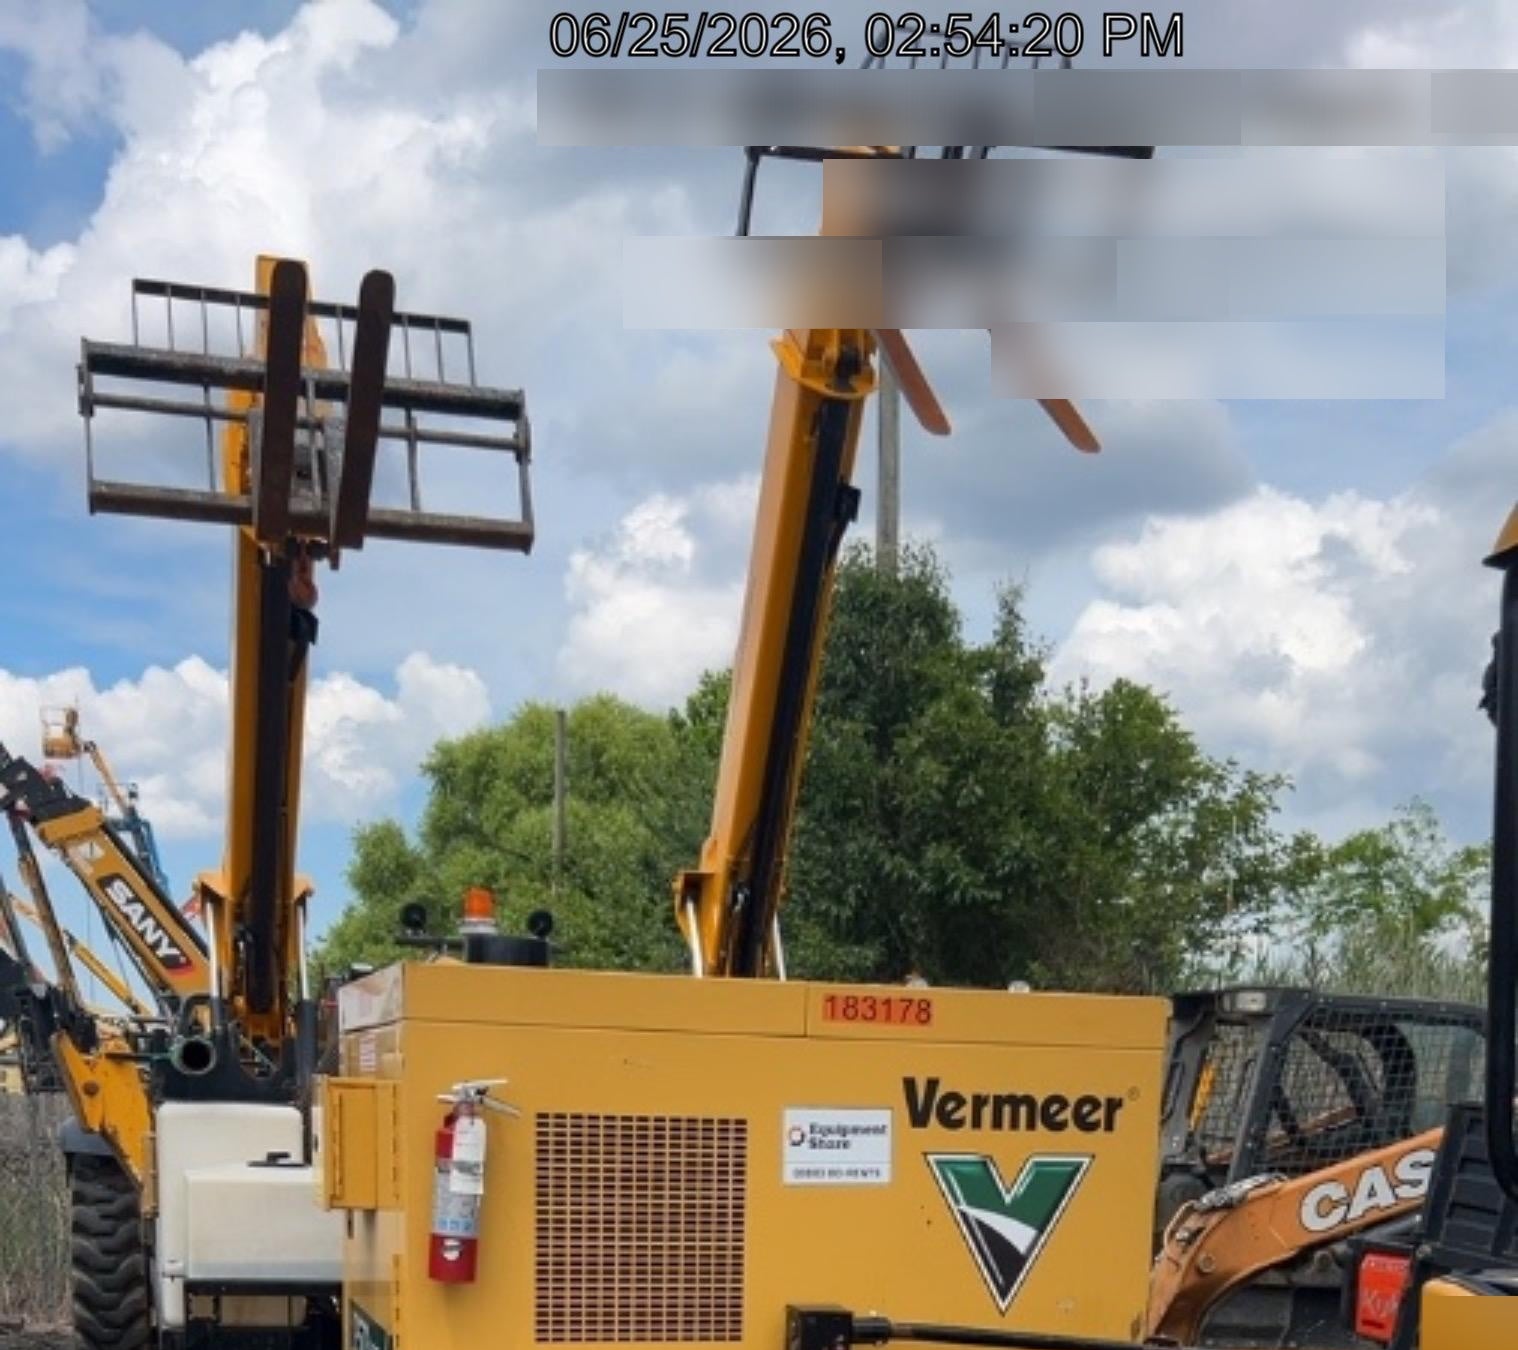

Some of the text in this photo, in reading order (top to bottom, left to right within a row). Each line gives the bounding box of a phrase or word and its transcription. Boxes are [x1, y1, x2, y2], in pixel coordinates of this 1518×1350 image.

[104, 878, 181, 957] SANY
[825, 995, 931, 1024] 183178
[902, 1076, 1124, 1132] Vermeer
[809, 1122, 887, 1137] Equipment
[809, 1136, 851, 1149] Share
[1300, 1148, 1437, 1232] CAS
